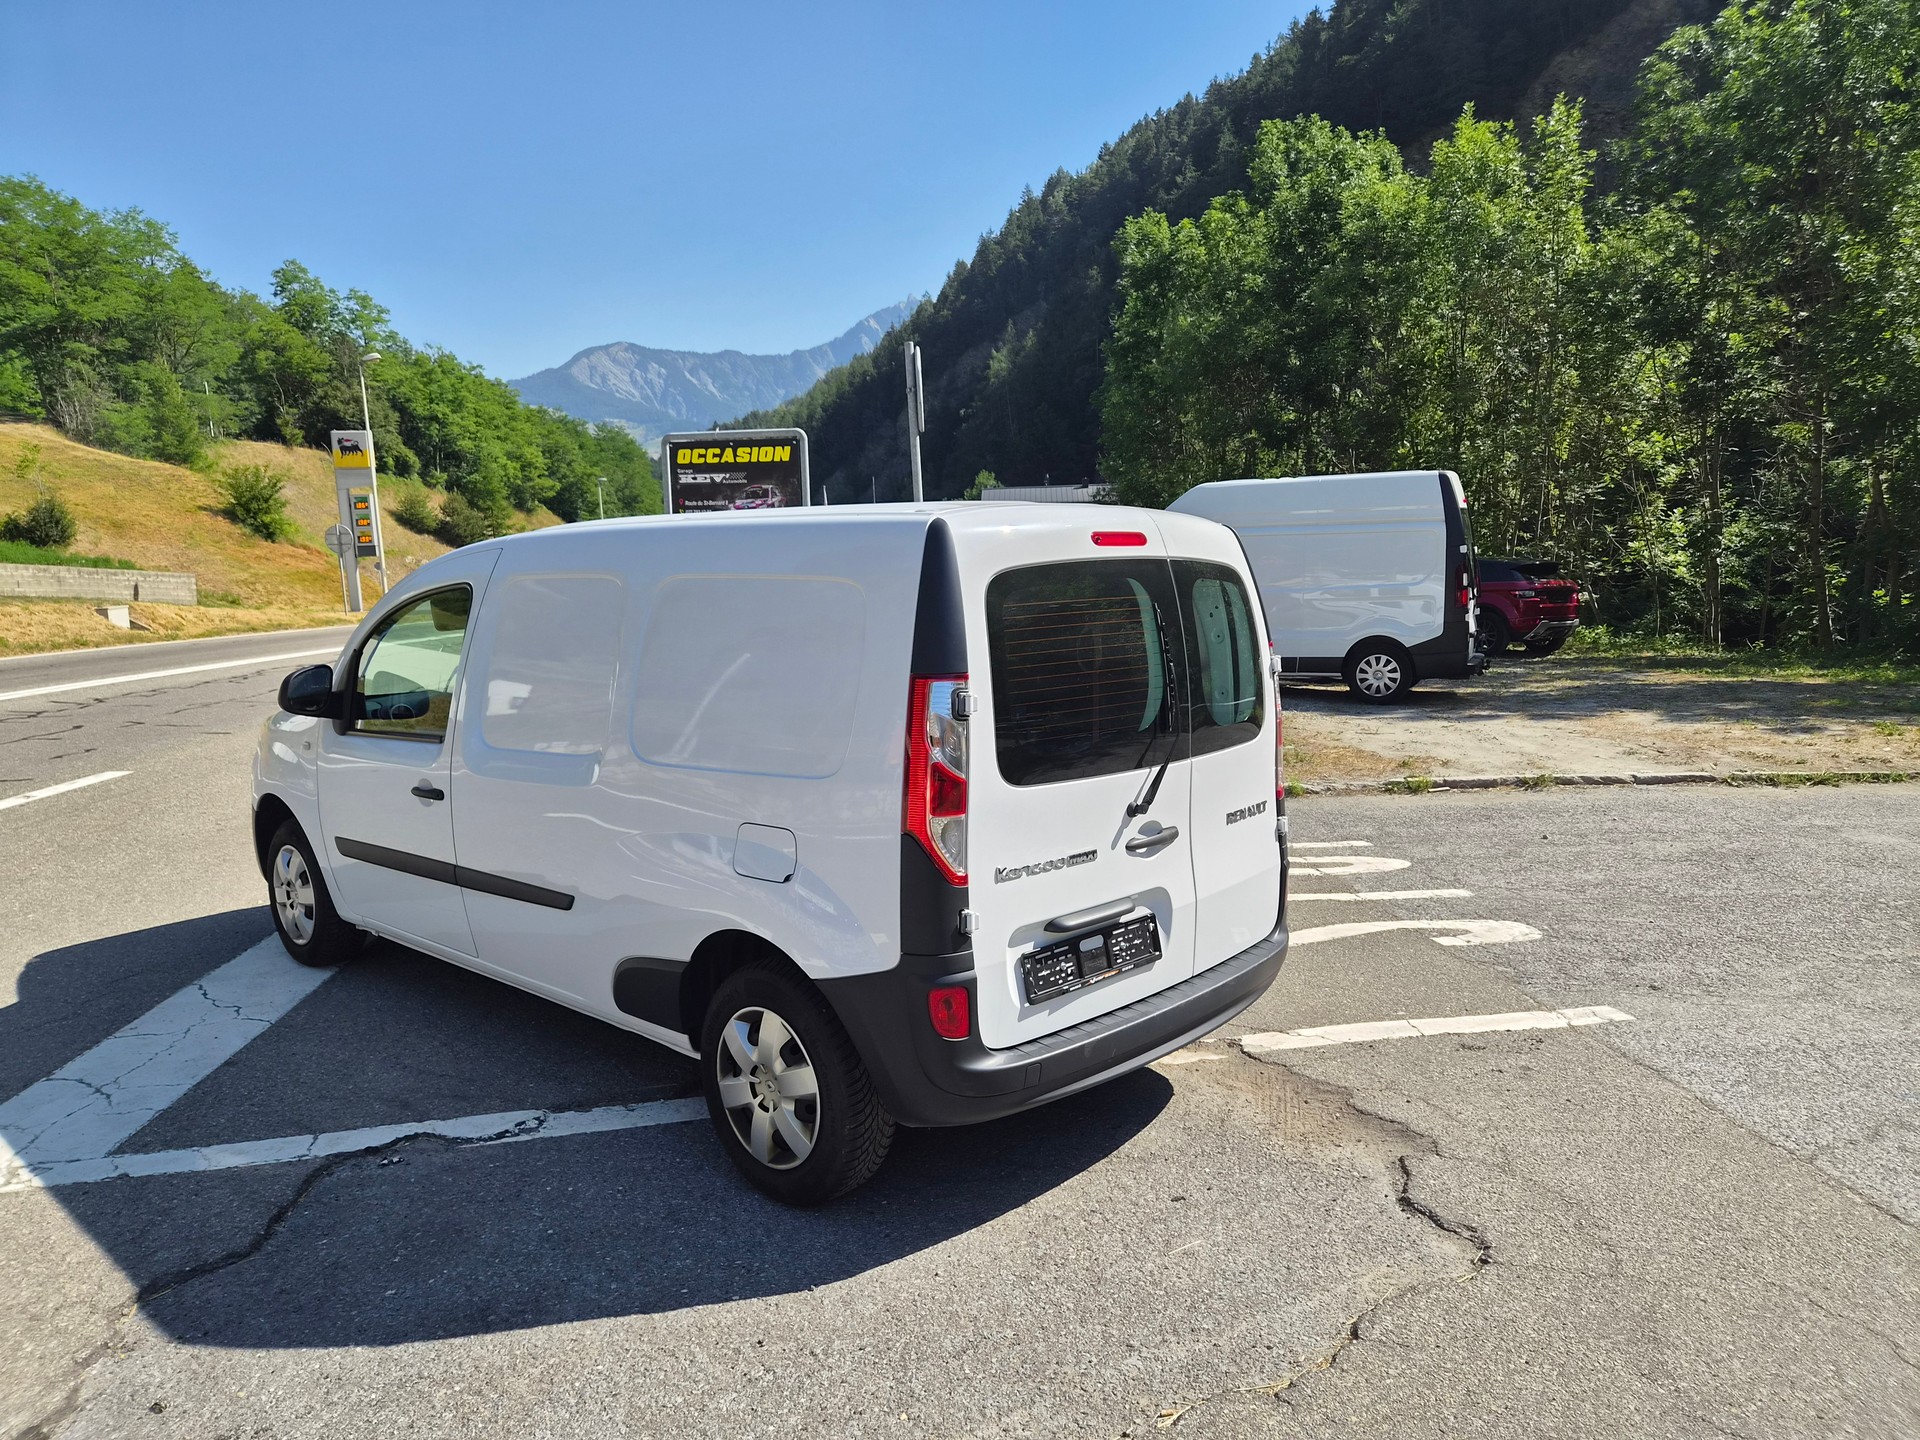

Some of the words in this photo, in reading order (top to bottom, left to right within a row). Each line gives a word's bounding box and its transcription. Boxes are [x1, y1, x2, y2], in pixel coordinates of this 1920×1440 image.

[677, 446, 791, 464] OCCASION
[1226, 800, 1268, 826] RENAULT
[994, 857, 1067, 884] Kangoo
